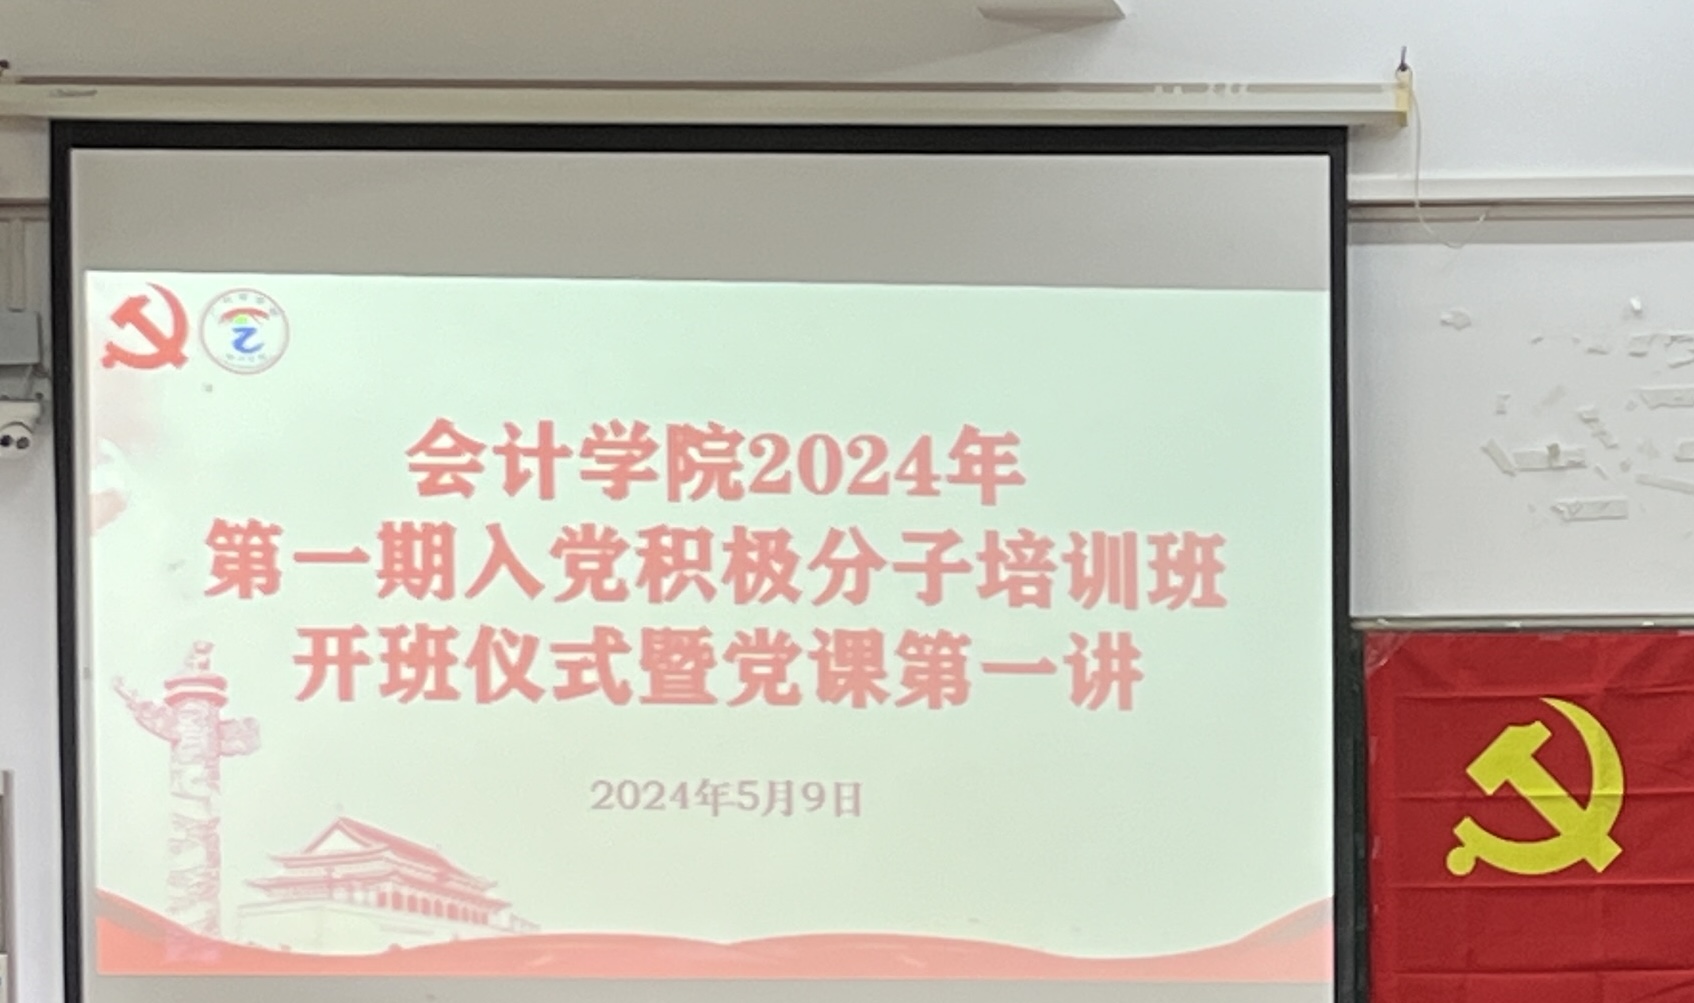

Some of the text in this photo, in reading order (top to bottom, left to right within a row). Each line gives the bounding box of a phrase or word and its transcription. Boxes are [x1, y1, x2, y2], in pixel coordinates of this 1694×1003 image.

[405, 417, 1026, 505] 会计学院2024年
[203, 518, 1228, 610] 第一期入党积极分子培训班
[292, 622, 1143, 711] 开班仪式暨党课第一讲
[590, 778, 862, 818] 2024年5月9日
